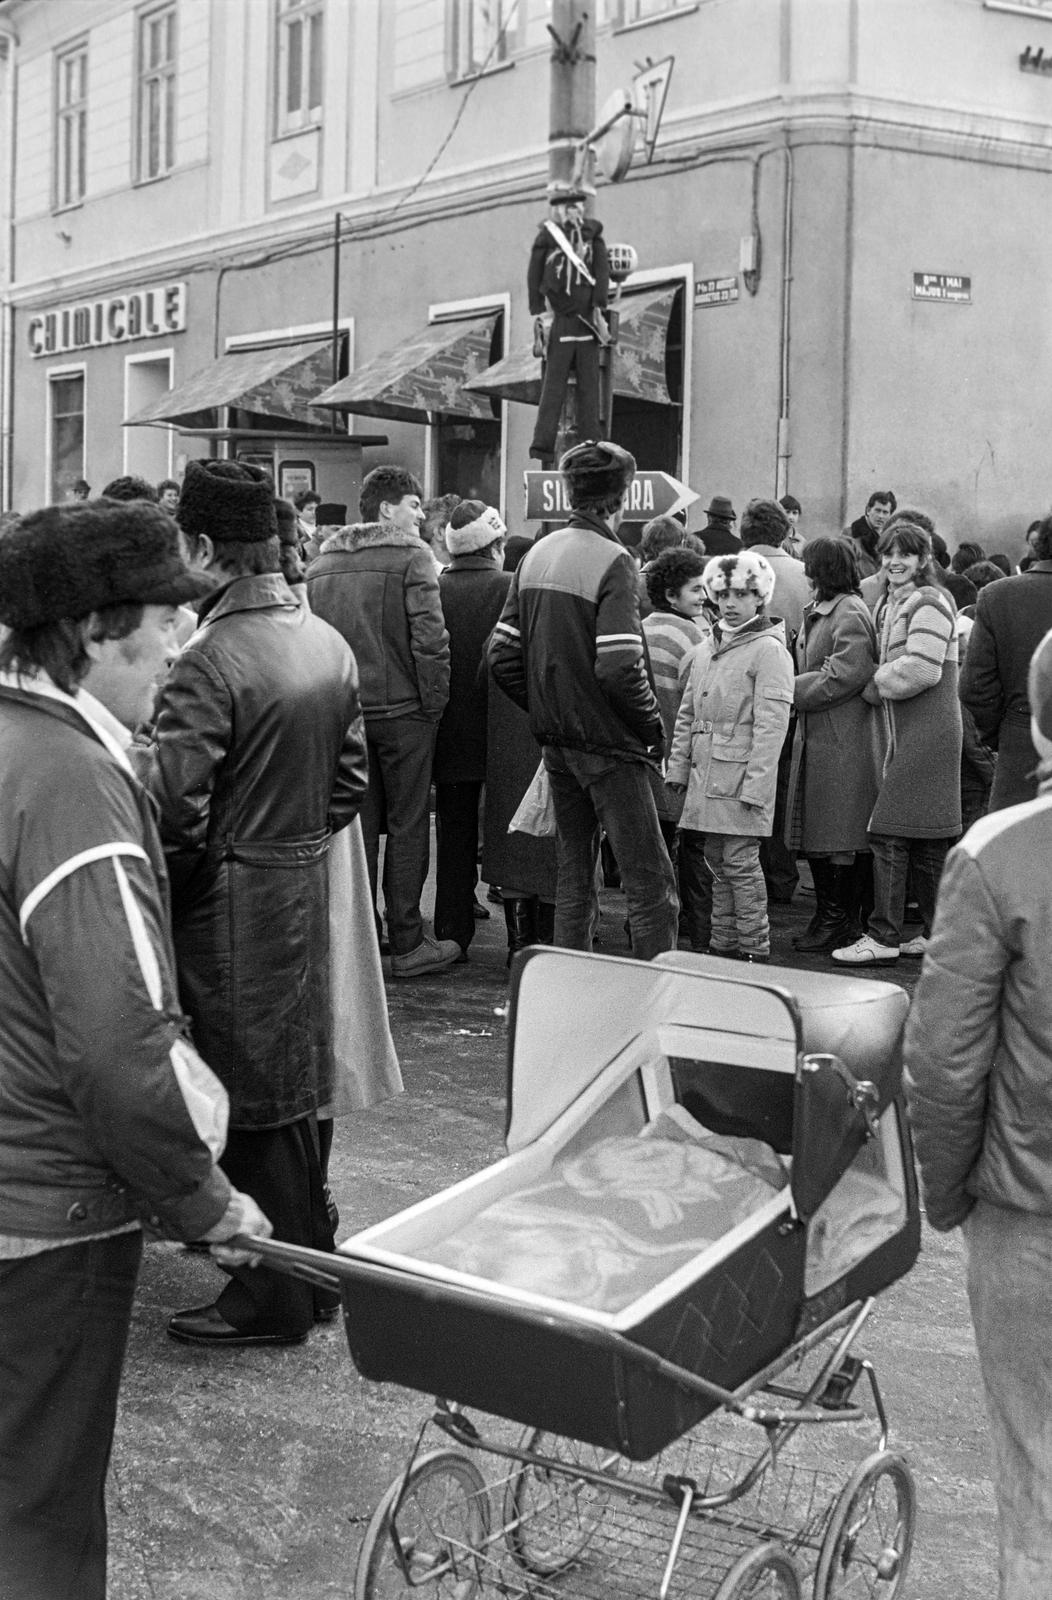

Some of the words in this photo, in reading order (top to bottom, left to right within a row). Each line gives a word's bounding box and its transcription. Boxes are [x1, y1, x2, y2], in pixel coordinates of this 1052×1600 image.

[607, 260, 631, 270] TONI
[946, 276, 962, 288] MAI
[27, 286, 180, 354] CHIMICALE
